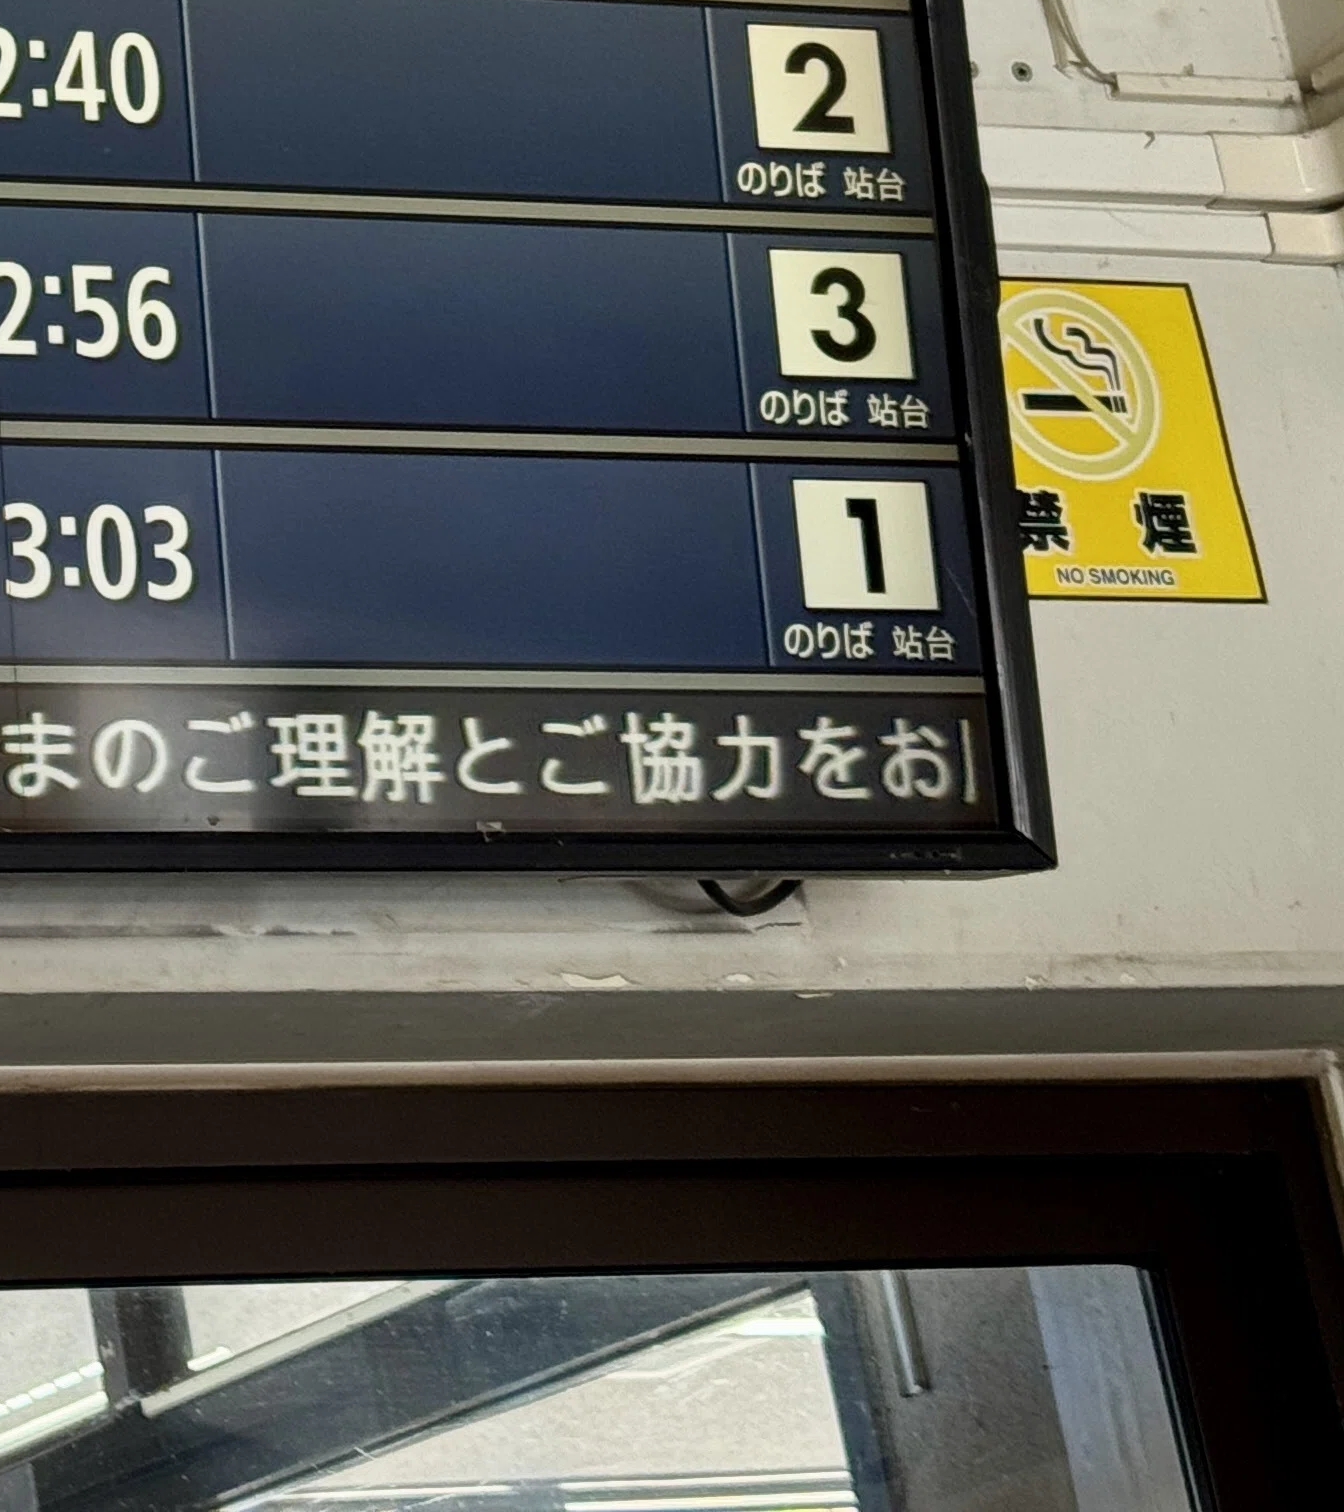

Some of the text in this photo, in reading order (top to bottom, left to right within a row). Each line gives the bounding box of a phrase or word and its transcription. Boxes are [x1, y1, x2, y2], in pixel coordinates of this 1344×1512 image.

[784, 42, 856, 135] 2
[737, 161, 906, 202] のりば 站台
[810, 266, 877, 364] 3
[760, 388, 930, 430] のりば 站台
[845, 497, 887, 595] 1
[1056, 567, 1175, 586] NO SMOKING
[783, 622, 956, 662] のりば 站台
